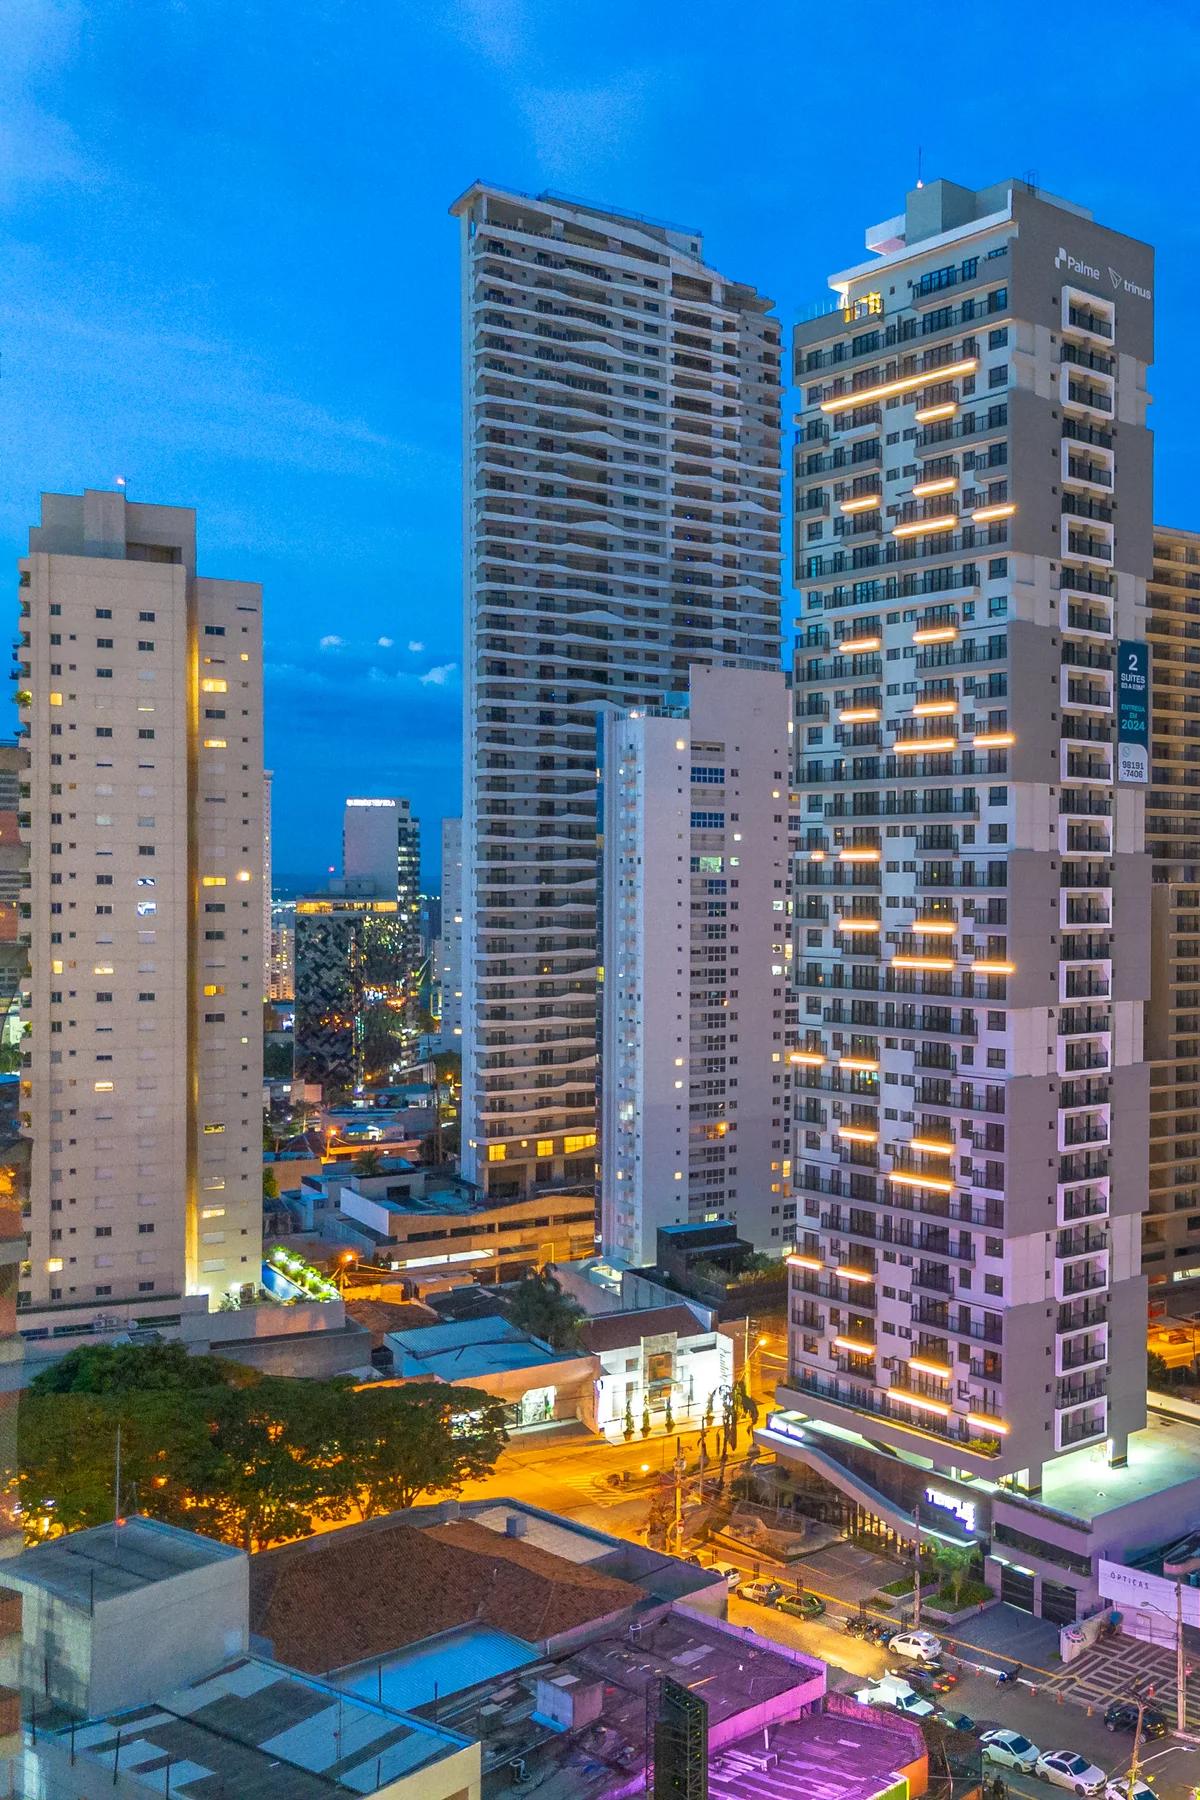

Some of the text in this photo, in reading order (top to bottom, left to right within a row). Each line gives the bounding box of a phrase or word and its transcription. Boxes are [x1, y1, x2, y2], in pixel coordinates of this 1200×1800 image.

[1068, 256, 1100, 280] Palme
[1124, 280, 1151, 299] trinus
[1128, 654, 1138, 671] 2
[1120, 672, 1146, 684] SUÍTES
[1121, 719, 1145, 731] 2024
[1110, 1571, 1149, 1590] ÓPTICAS
